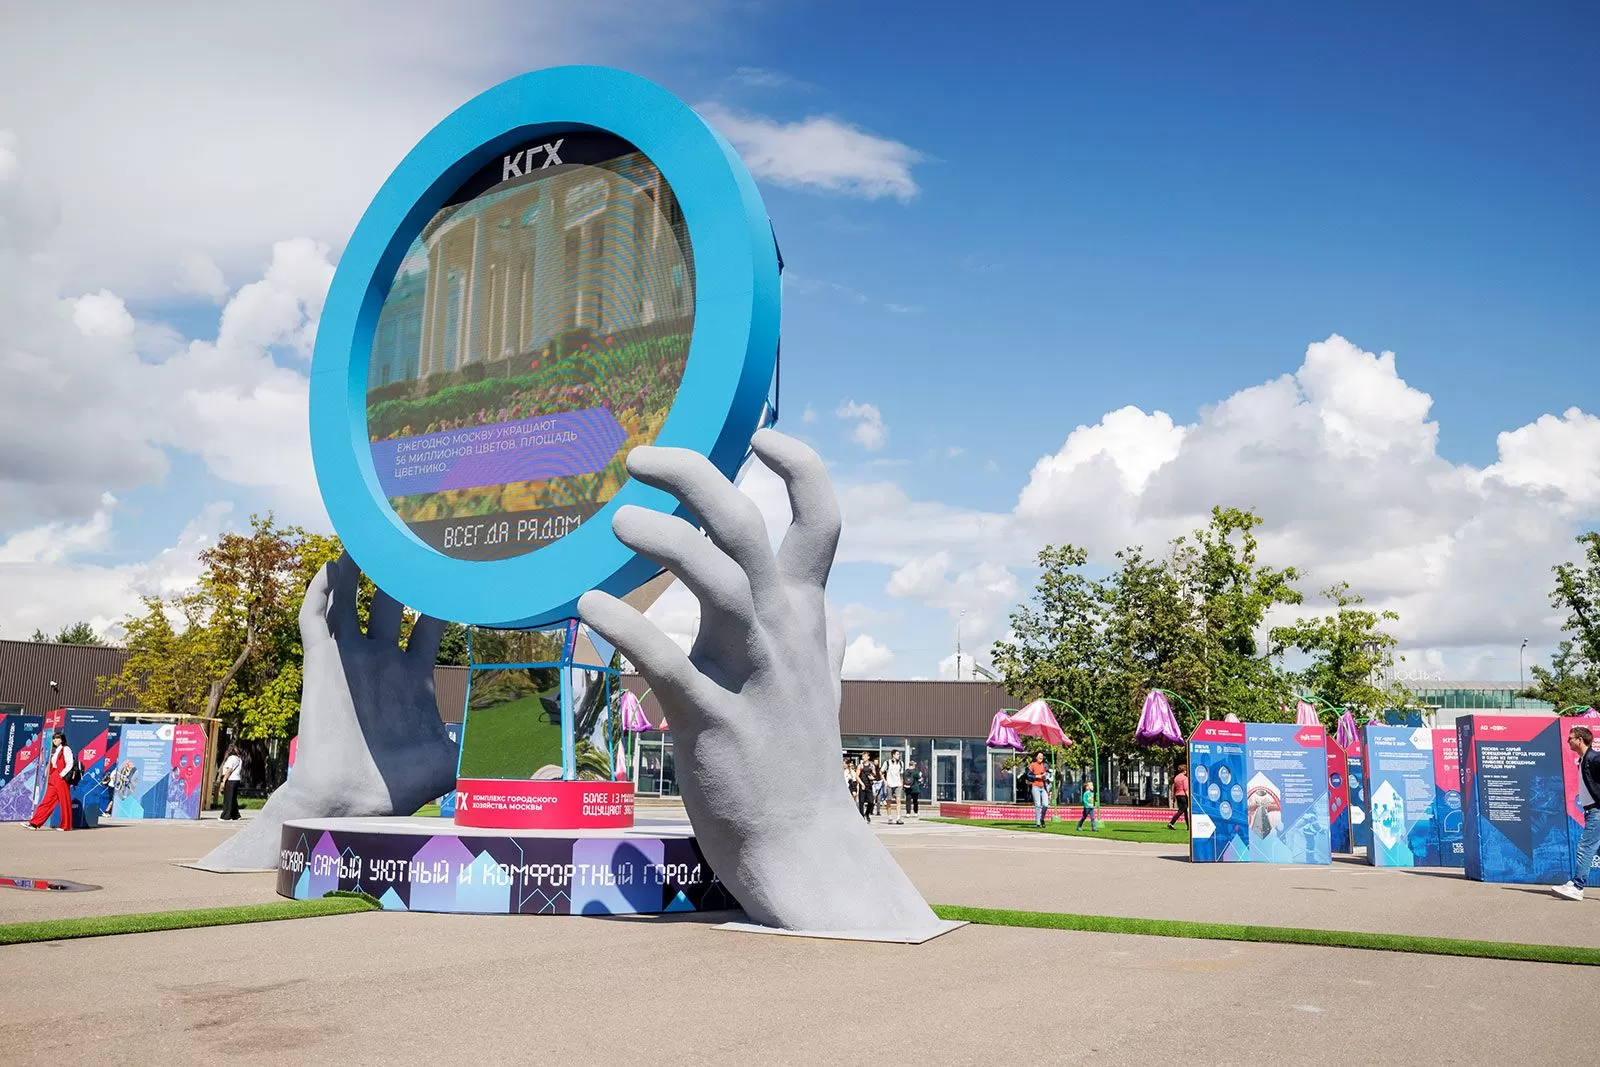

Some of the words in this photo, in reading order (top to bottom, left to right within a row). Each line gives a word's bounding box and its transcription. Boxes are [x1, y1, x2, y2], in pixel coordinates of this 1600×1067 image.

[503, 138, 564, 181] КГХ
[396, 455, 406, 465] 56
[408, 445, 473, 463] МИЛЛИОНОВ
[520, 431, 578, 447] ПЛОЩАДЬ
[397, 435, 451, 453] ЕЖЕГОДНО
[452, 428, 494, 445] МОСКВУ
[496, 420, 557, 438] УКРАШАЮТ
[443, 521, 509, 548] ВСЕГДА
[517, 514, 581, 541] РЯДОМ
[455, 792, 469, 811] ГХ
[509, 803, 543, 811] МОСКВЫ
[583, 793, 609, 804] БОЛЕЕ
[611, 793, 620, 804] 13
[583, 805, 622, 816] ОЩУЩАЮТ
[313, 854, 362, 879] САМЫЙ
[369, 859, 449, 884] УЮТНЫЙ
[459, 863, 473, 885] И
[482, 863, 634, 887] КОМФОРТНЫЙ
[641, 863, 703, 885] ГОРОД
